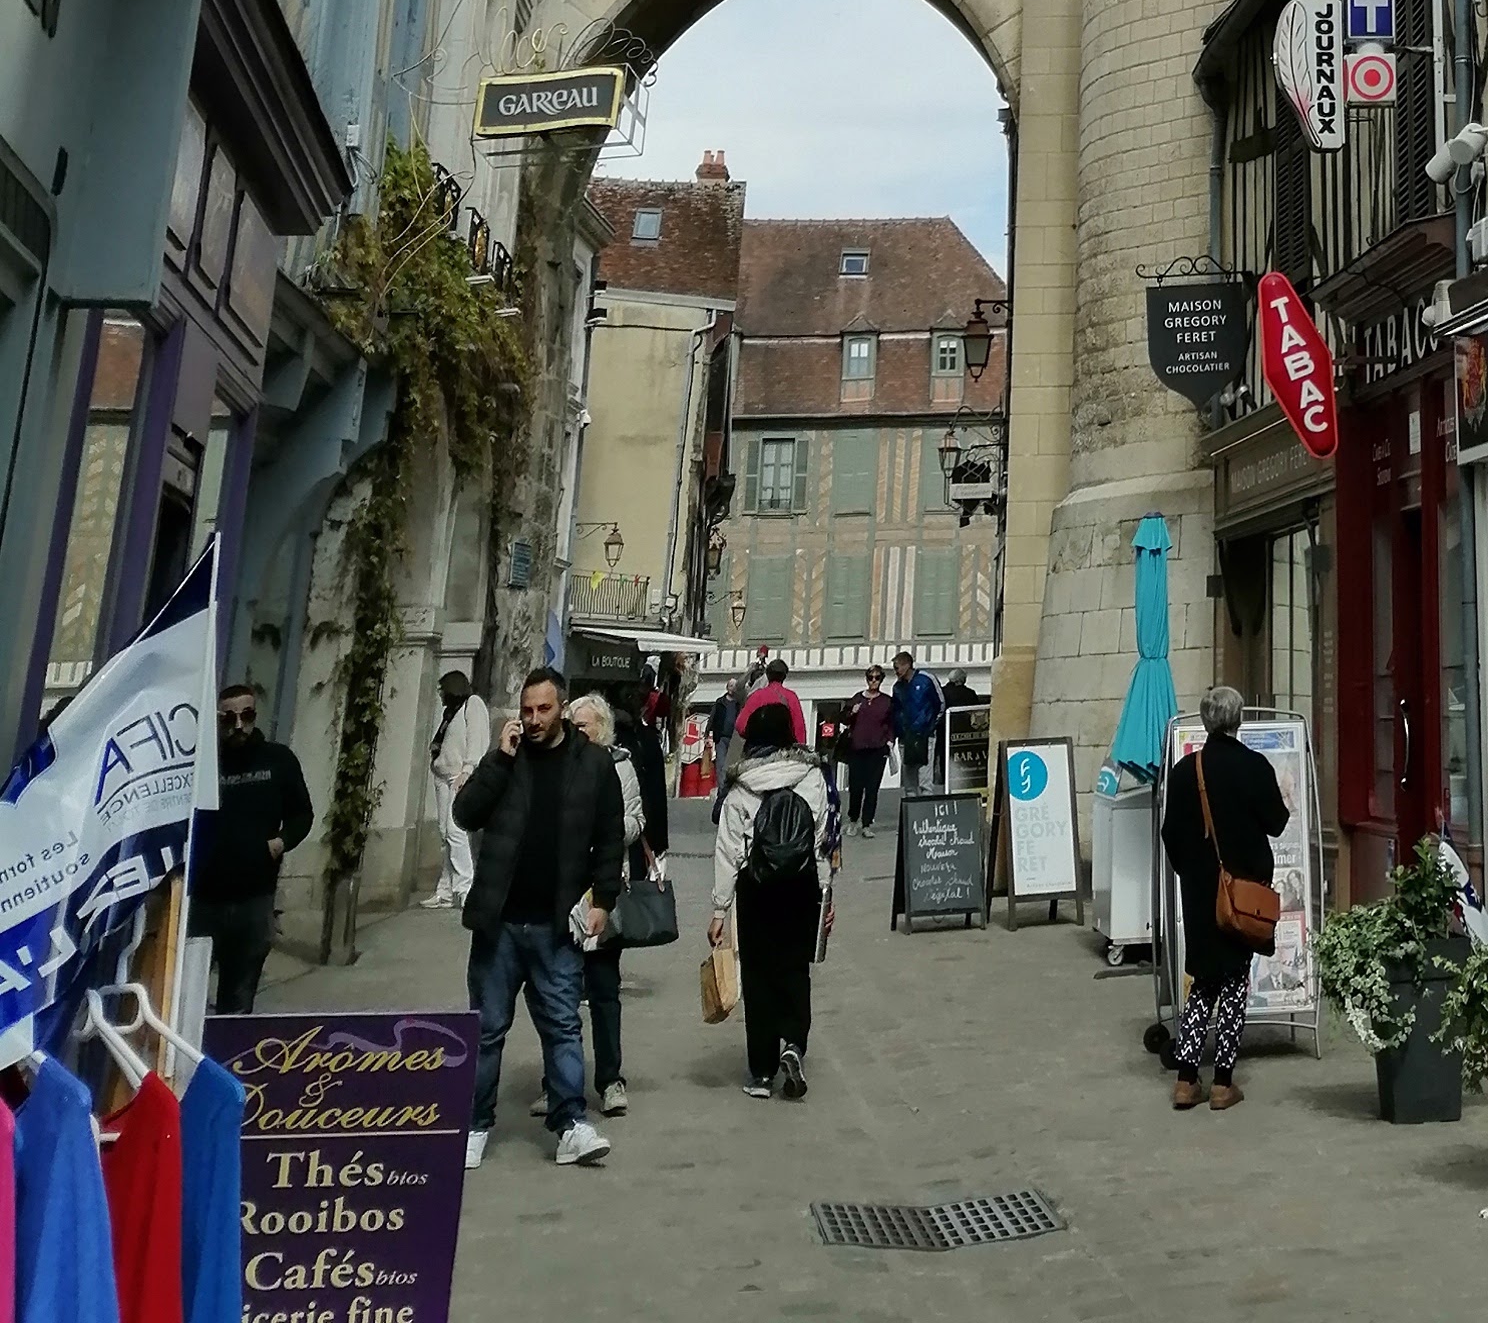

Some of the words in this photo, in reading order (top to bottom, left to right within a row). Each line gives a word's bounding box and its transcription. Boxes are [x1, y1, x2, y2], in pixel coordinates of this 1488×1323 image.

[1315, 3, 1337, 135] JOURNAUX
[498, 87, 599, 116] GARREAU
[1168, 299, 1222, 313] MAISON
[1164, 314, 1227, 328] GREGORY
[1176, 330, 1217, 343] FERET
[1166, 362, 1230, 374] CHOCOLATIER
[1178, 351, 1218, 361] ARTISAN
[1270, 296, 1328, 433] TABAC
[601, 655, 631, 668] BOUTIQUE
[954, 751, 973, 762] BAR
[233, 1025, 447, 1074] Arômes
[299, 1072, 343, 1108] &
[266, 1149, 385, 1189] Thés
[386, 1169, 429, 1187] bios
[241, 1195, 405, 1235] Rooibos
[245, 1248, 375, 1291] Cafés
[376, 1269, 418, 1285] bios
[241, 1301, 335, 1323] icerie
